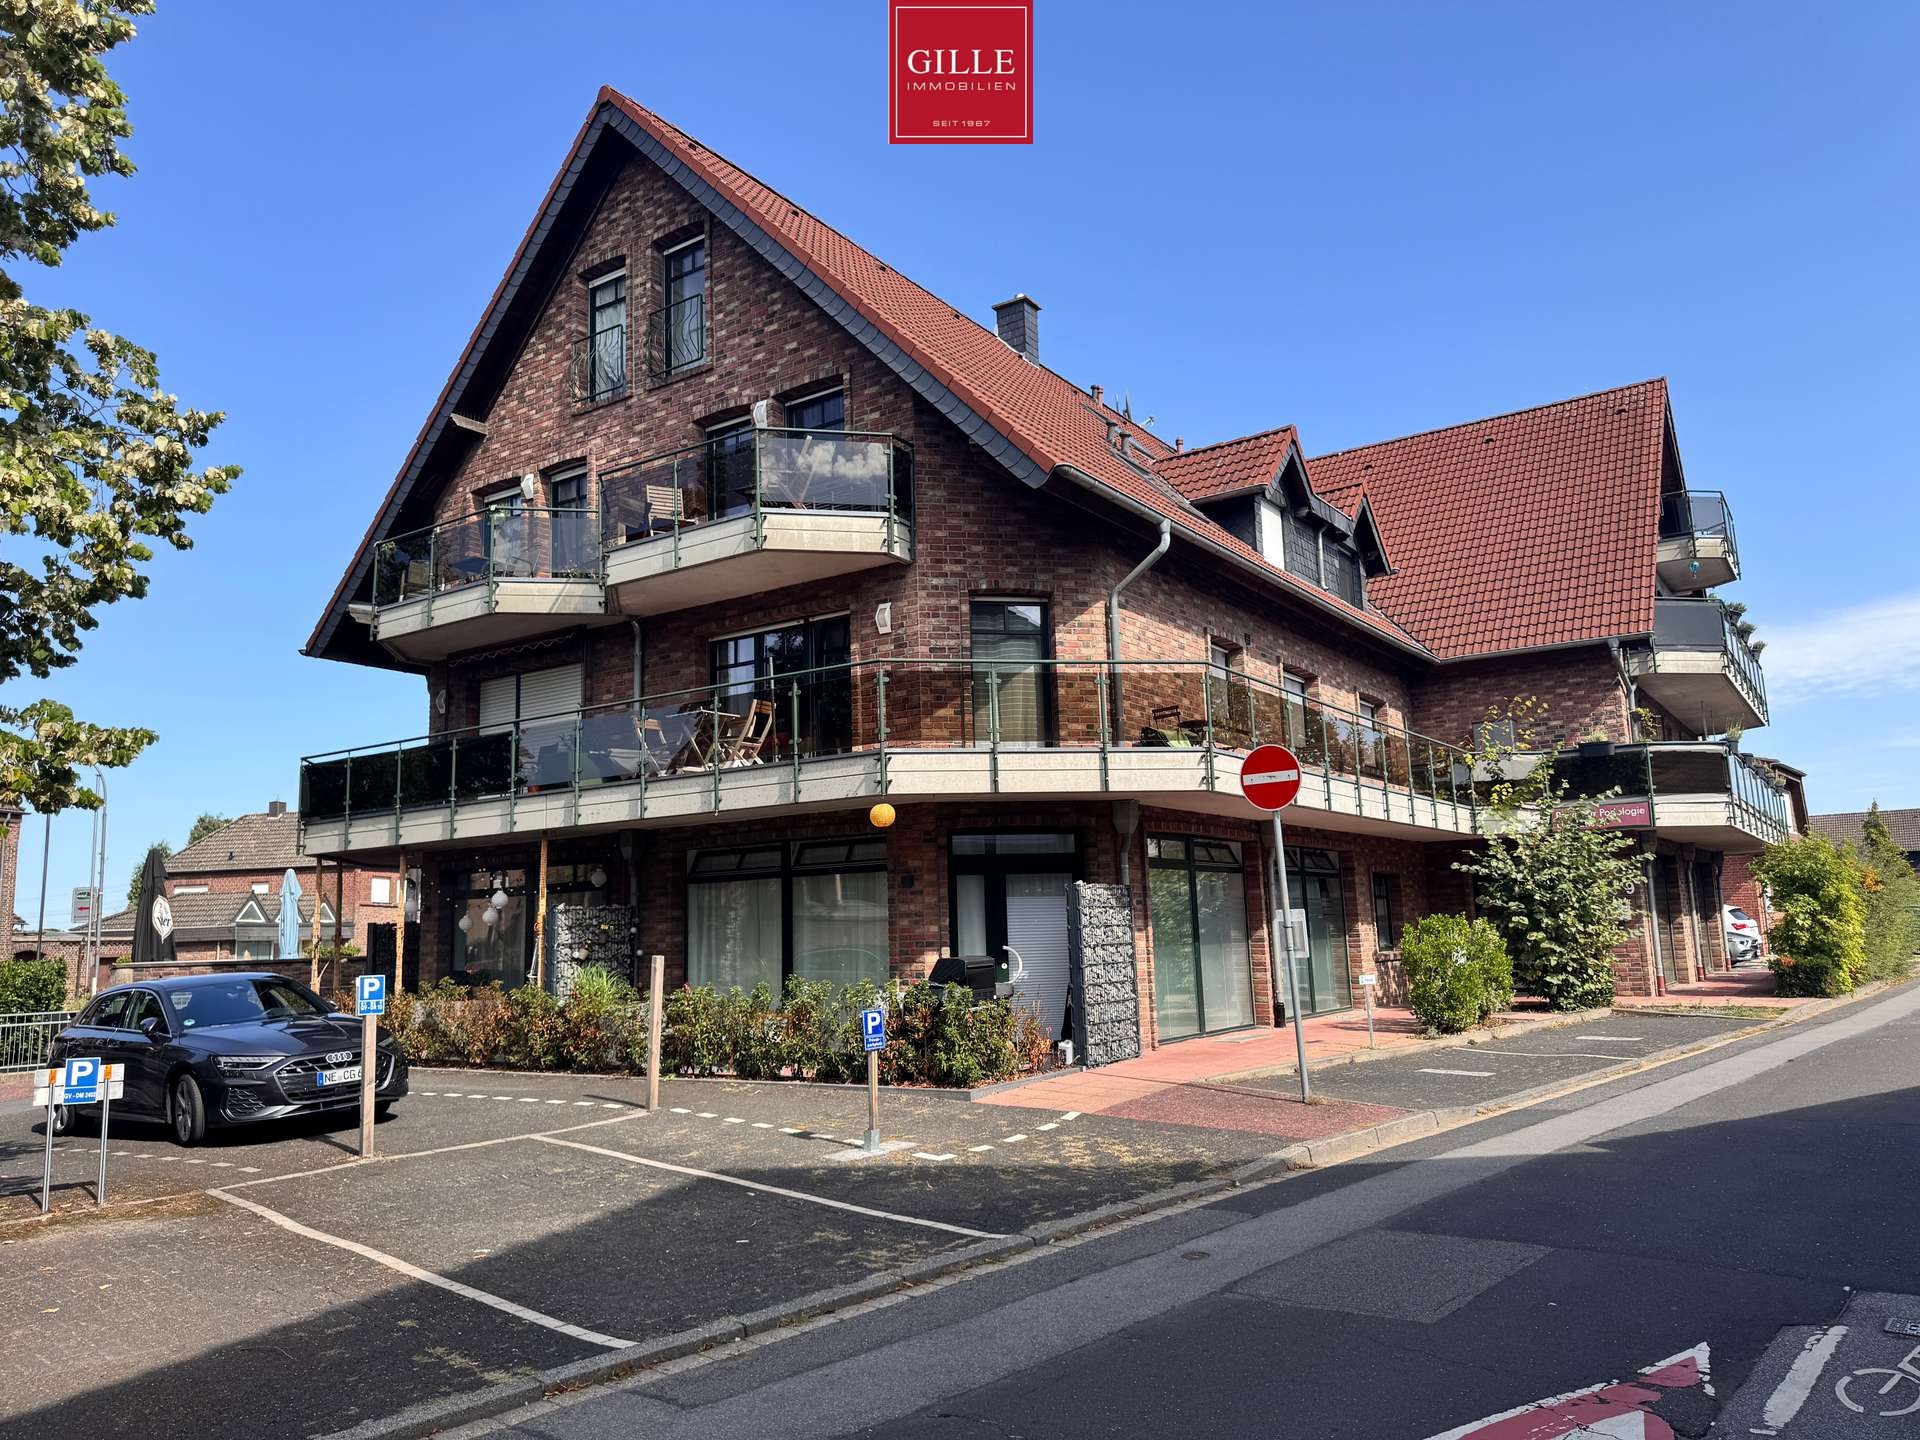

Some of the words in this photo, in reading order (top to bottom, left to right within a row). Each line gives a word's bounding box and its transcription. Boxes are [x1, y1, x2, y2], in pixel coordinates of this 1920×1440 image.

[364, 978, 380, 999] P
[867, 1012, 881, 1035] P
[70, 1061, 94, 1086] P
[325, 1071, 337, 1083] NE
[343, 1069, 356, 1080] CG
